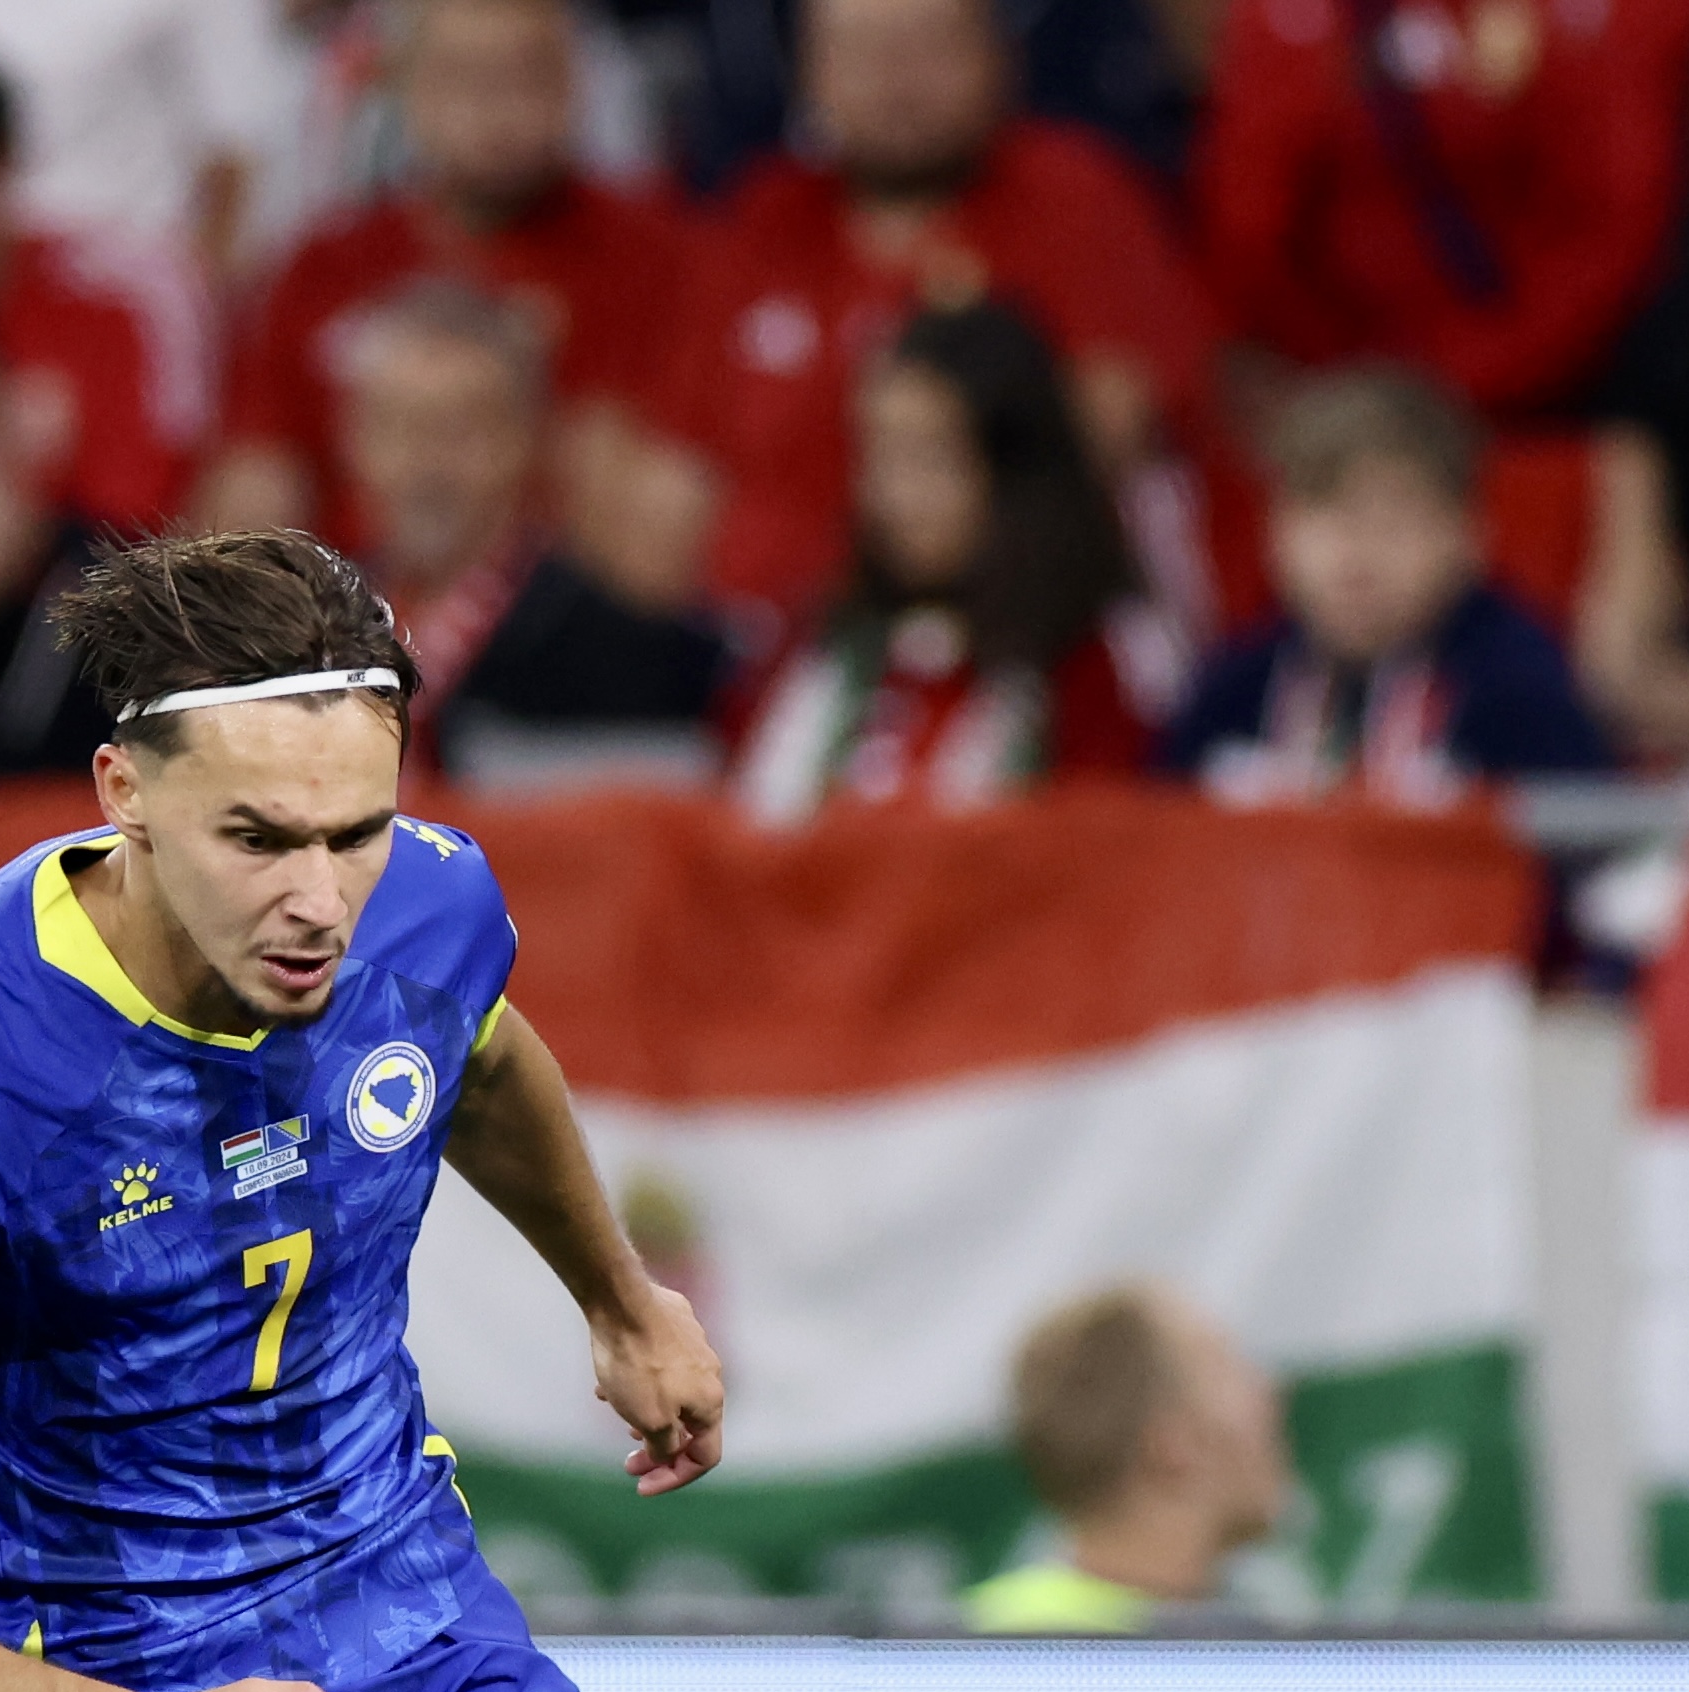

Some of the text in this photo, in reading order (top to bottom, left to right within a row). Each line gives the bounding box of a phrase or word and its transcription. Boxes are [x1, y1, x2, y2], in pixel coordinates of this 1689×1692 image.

[244, 1150, 292, 1176] 10.09.2024
[99, 1195, 174, 1232] KELME
[242, 1228, 314, 1392] 7
